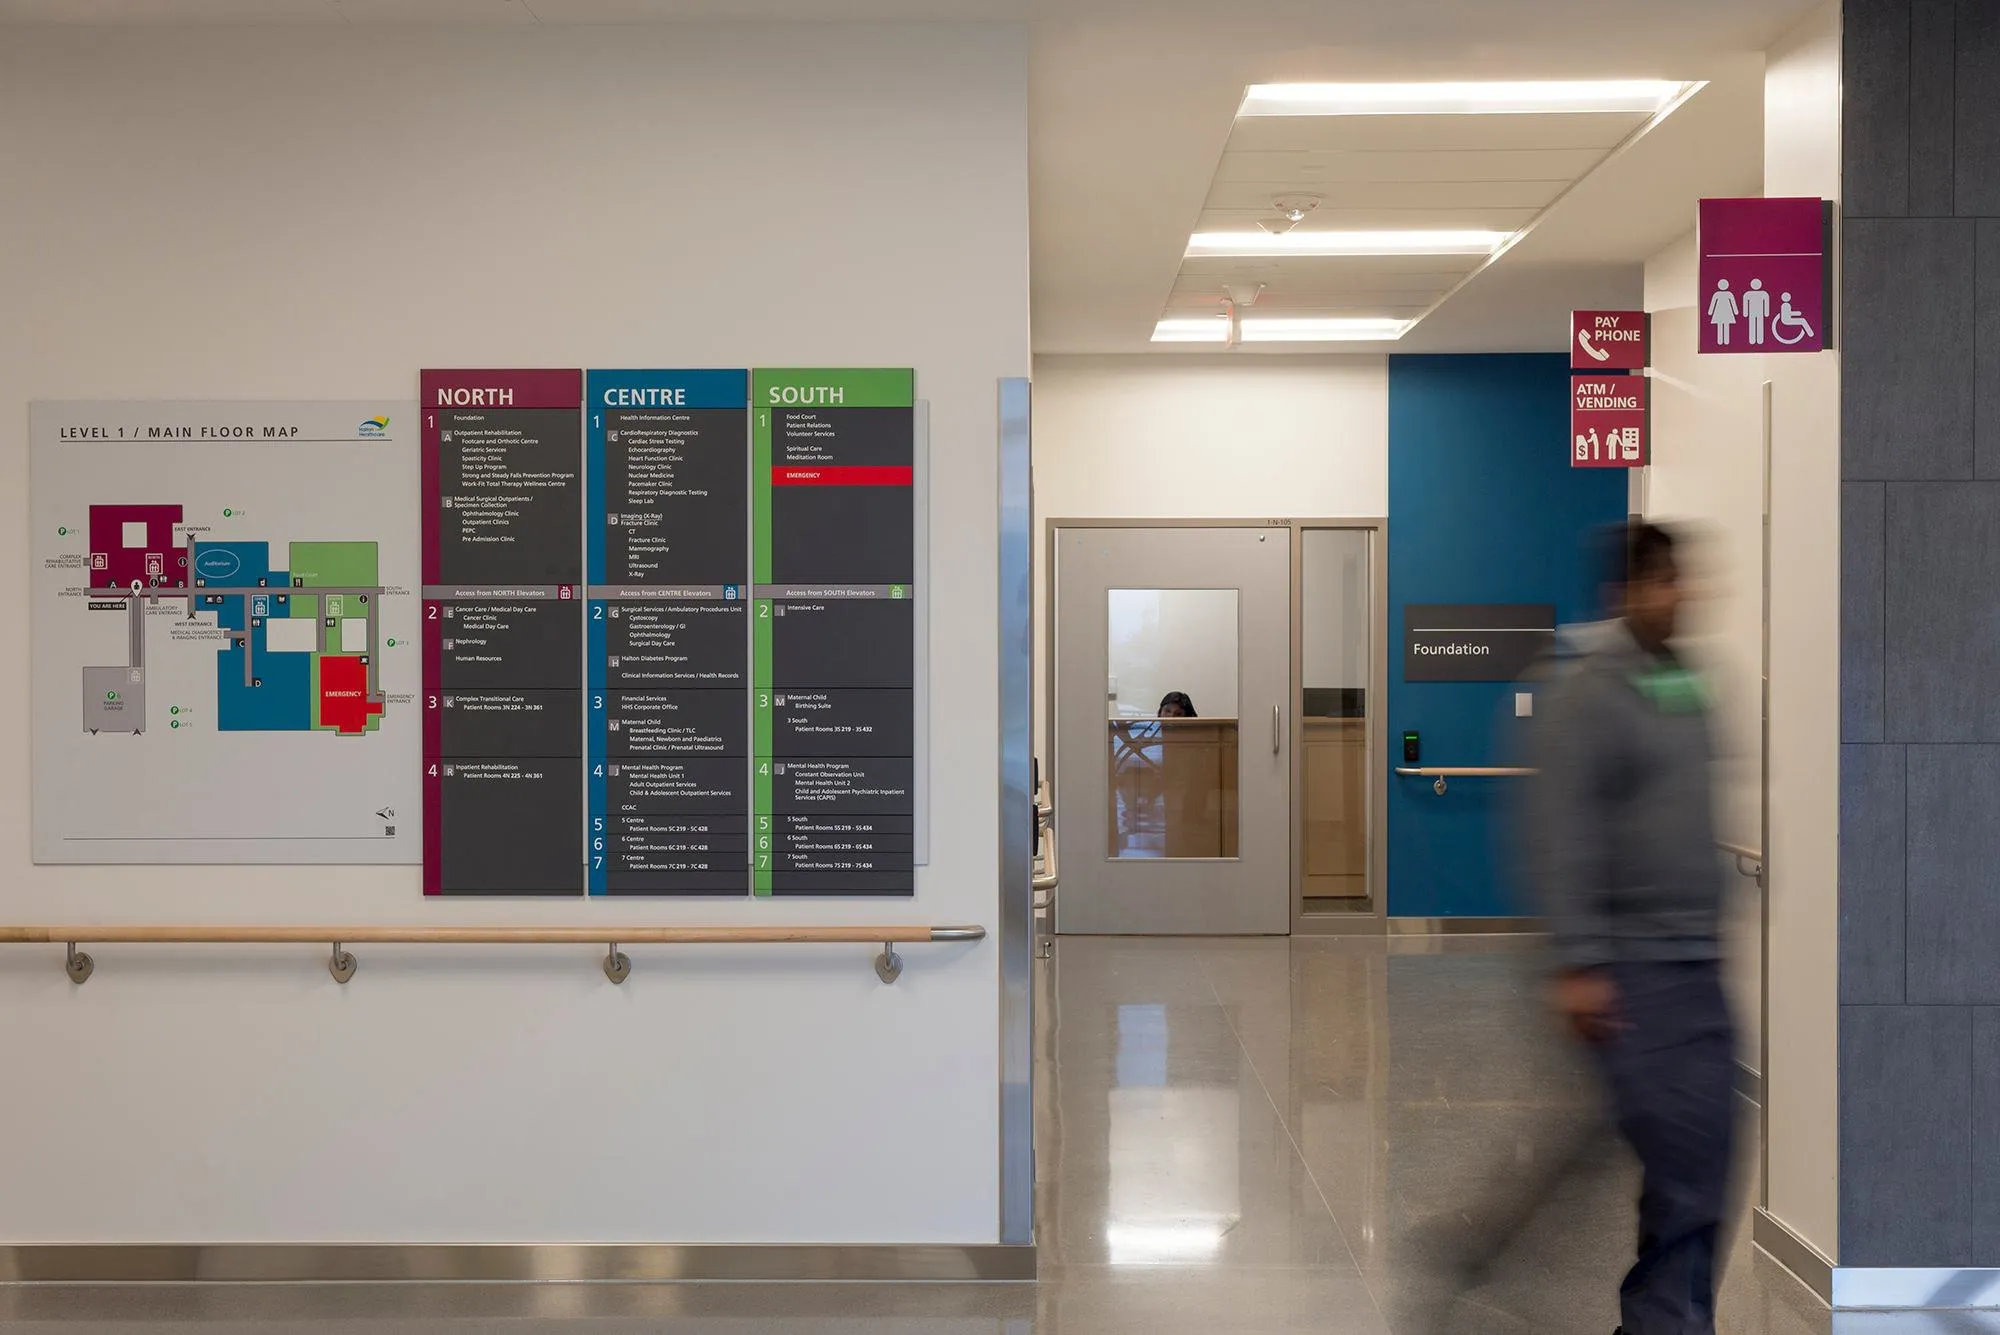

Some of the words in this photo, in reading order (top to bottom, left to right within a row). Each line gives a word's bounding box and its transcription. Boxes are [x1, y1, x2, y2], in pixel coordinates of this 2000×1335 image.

[1595, 317, 1620, 327] PAY
[1595, 330, 1640, 341] PHONE
[1577, 384, 1606, 395] ATM
[1610, 384, 1615, 395] /
[438, 388, 513, 405] NORTH
[604, 388, 685, 405] CENTRE
[769, 387, 844, 404] SOUTH
[1577, 397, 1637, 409] VENDING
[428, 415, 434, 428] 1
[593, 415, 599, 428] 1
[759, 414, 765, 427] 1
[60, 426, 109, 438] LEVEL
[118, 426, 123, 438] 1
[134, 426, 139, 438] /
[148, 426, 191, 438] MAIN
[201, 426, 254, 438] FLOOR
[263, 426, 299, 438] MAP
[453, 429, 484, 437] Outpatient
[620, 429, 669, 437] CardioRespiratory
[668, 429, 699, 437] Diagnostics
[443, 433, 452, 442] A
[611, 433, 619, 442] C
[628, 447, 676, 455] Echocardiography
[786, 445, 809, 453] Spiritual
[462, 455, 488, 463] Spasticity
[462, 464, 475, 472] Step
[474, 464, 484, 472] Up
[483, 464, 507, 472] Program
[628, 464, 657, 472] Neurology
[628, 489, 659, 497] Respiratory
[659, 489, 688, 497] Diagnostic
[688, 489, 708, 497] Testing
[445, 500, 452, 508] B
[454, 502, 480, 510] Specimen
[462, 519, 492, 527] Outpatient
[610, 516, 618, 525] D
[628, 545, 669, 553] Mammography
[628, 571, 645, 579] X-Ray
[110, 581, 117, 589] A
[428, 607, 437, 619] 2
[593, 607, 602, 619] 2
[611, 610, 619, 618] G
[759, 605, 768, 617] 2
[455, 638, 487, 646] Nephrology
[1413, 643, 1489, 655] Foundation
[665, 655, 688, 663] Program
[255, 679, 262, 687] D
[429, 696, 437, 708] 3
[446, 699, 454, 708] K
[455, 695, 479, 703] Complex
[594, 696, 602, 709] 3
[759, 695, 768, 707] 3
[775, 698, 785, 707] M
[795, 703, 817, 711] Birthing
[610, 723, 619, 732] M
[428, 765, 437, 776] 4
[447, 768, 454, 776] R
[593, 765, 603, 777] 4
[759, 763, 768, 776] 4
[388, 809, 395, 817] N
[594, 818, 602, 831] 5
[760, 817, 768, 829] 5
[594, 837, 602, 850] 6
[760, 836, 768, 849] 6
[594, 857, 603, 869] 7
[759, 856, 768, 868] 7
